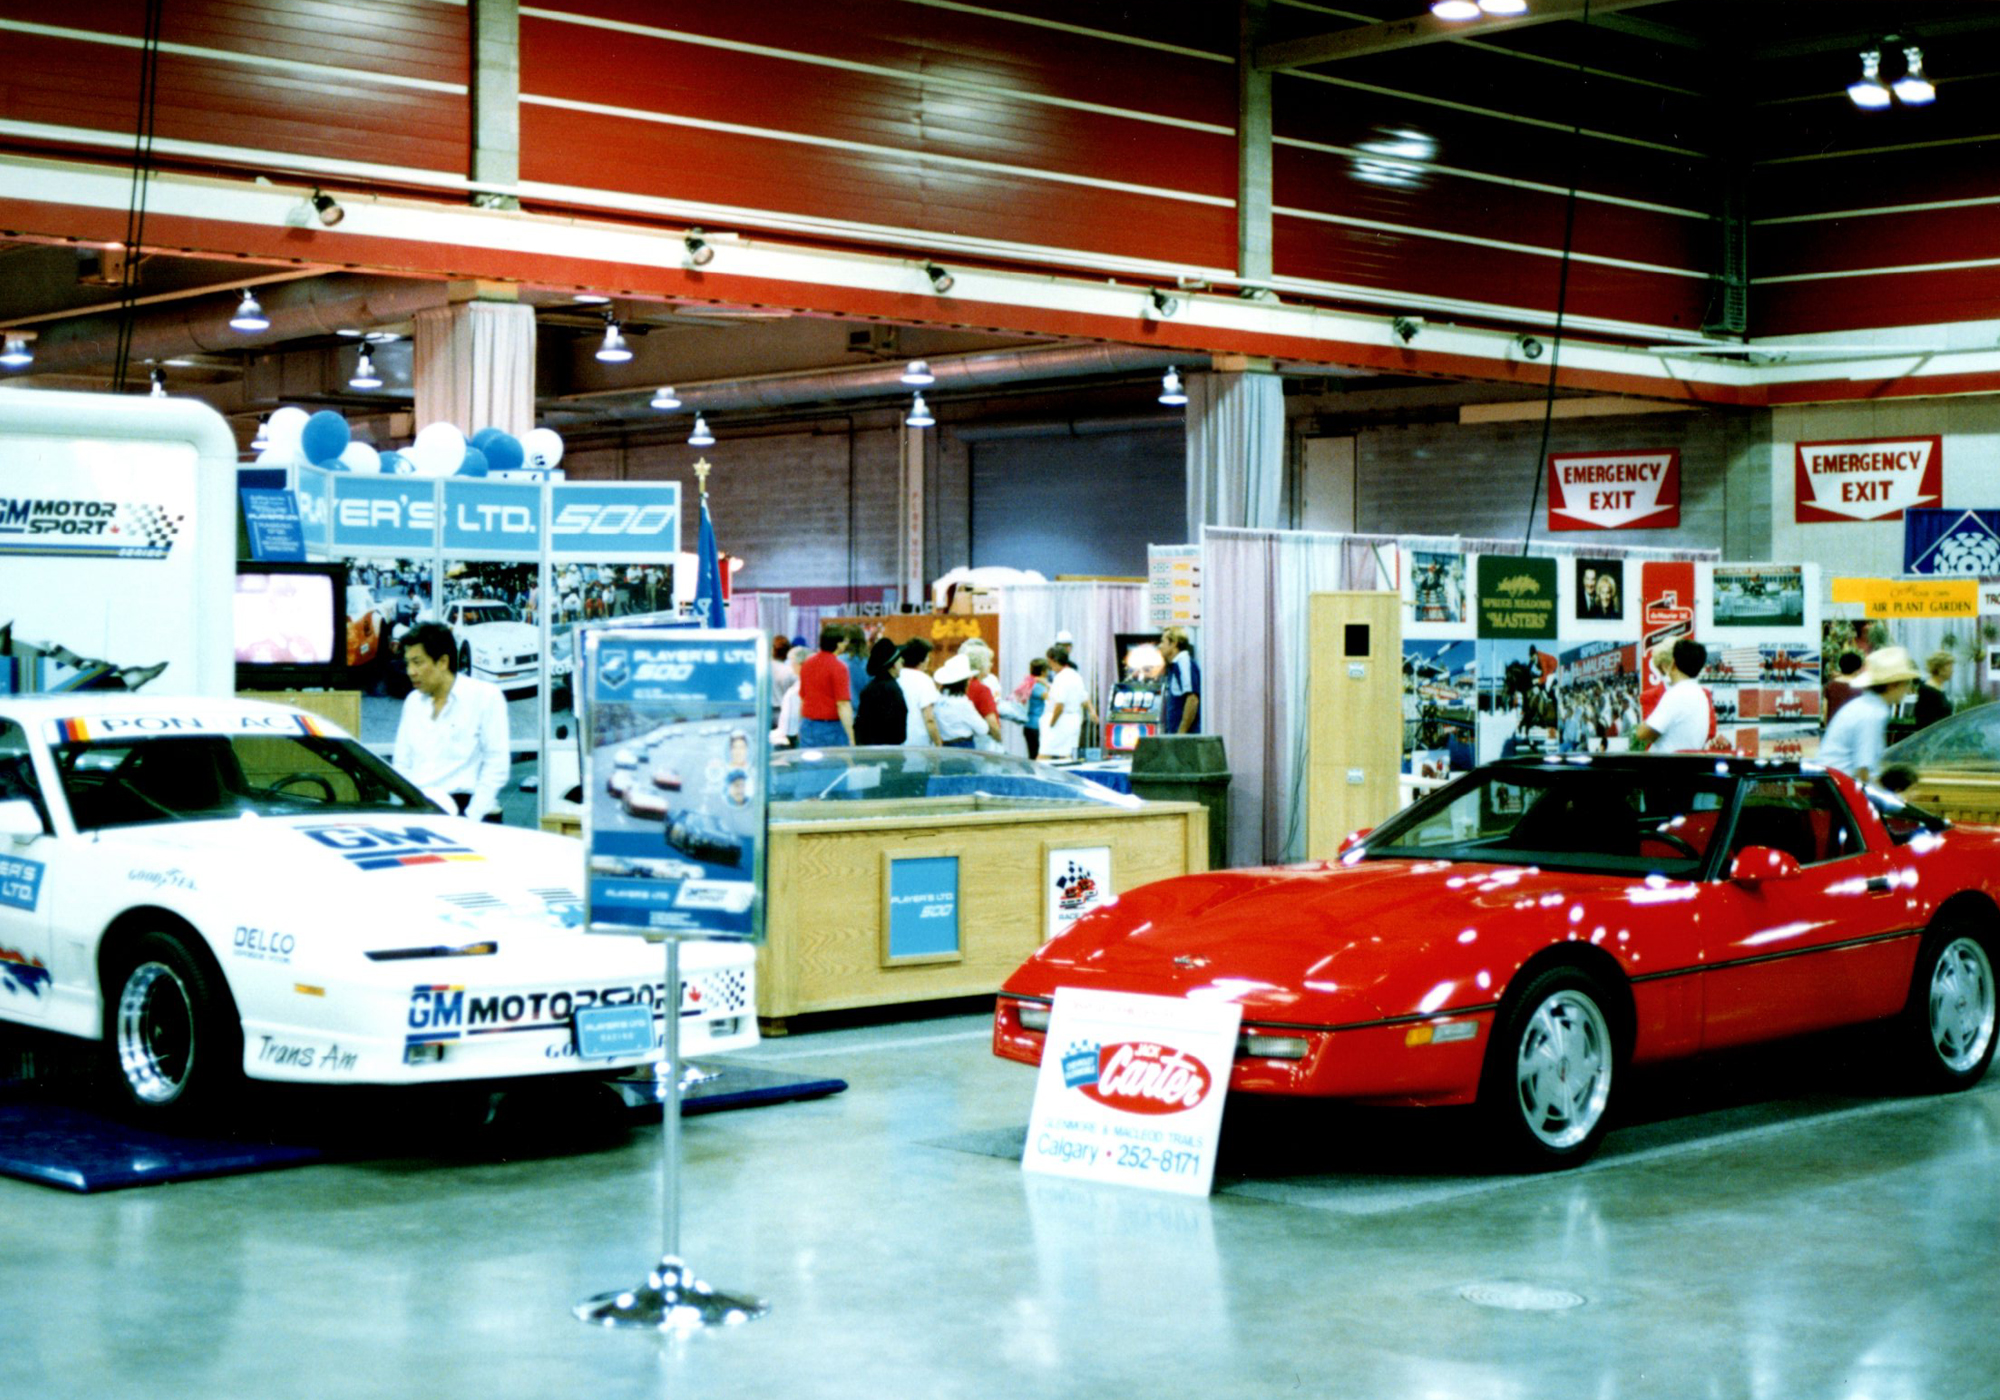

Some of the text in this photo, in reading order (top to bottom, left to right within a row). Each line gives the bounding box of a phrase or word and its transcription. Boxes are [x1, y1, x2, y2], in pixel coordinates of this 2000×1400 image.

[1563, 462, 1661, 485] EMERGENCY
[1812, 450, 1922, 475] EMERGENCY
[1589, 490, 1636, 511] EXIT
[1842, 480, 1894, 503] EXIT
[33, 499, 117, 518] MOTOR
[457, 503, 537, 534] LTD.
[550, 504, 674, 535] 500
[29, 518, 108, 535] SPORT
[1871, 601, 1972, 613] AIR PLANT GARDEN
[633, 663, 695, 682] 500
[100, 714, 295, 732] PONAC
[302, 826, 460, 850] GM
[919, 903, 954, 919] 500
[233, 925, 295, 955] DELCO
[407, 990, 464, 1029] GM
[258, 1034, 359, 1072] Trans Am
[1097, 1043, 1204, 1107] Carter
[1036, 1132, 1201, 1177] Calgary 252-8171
